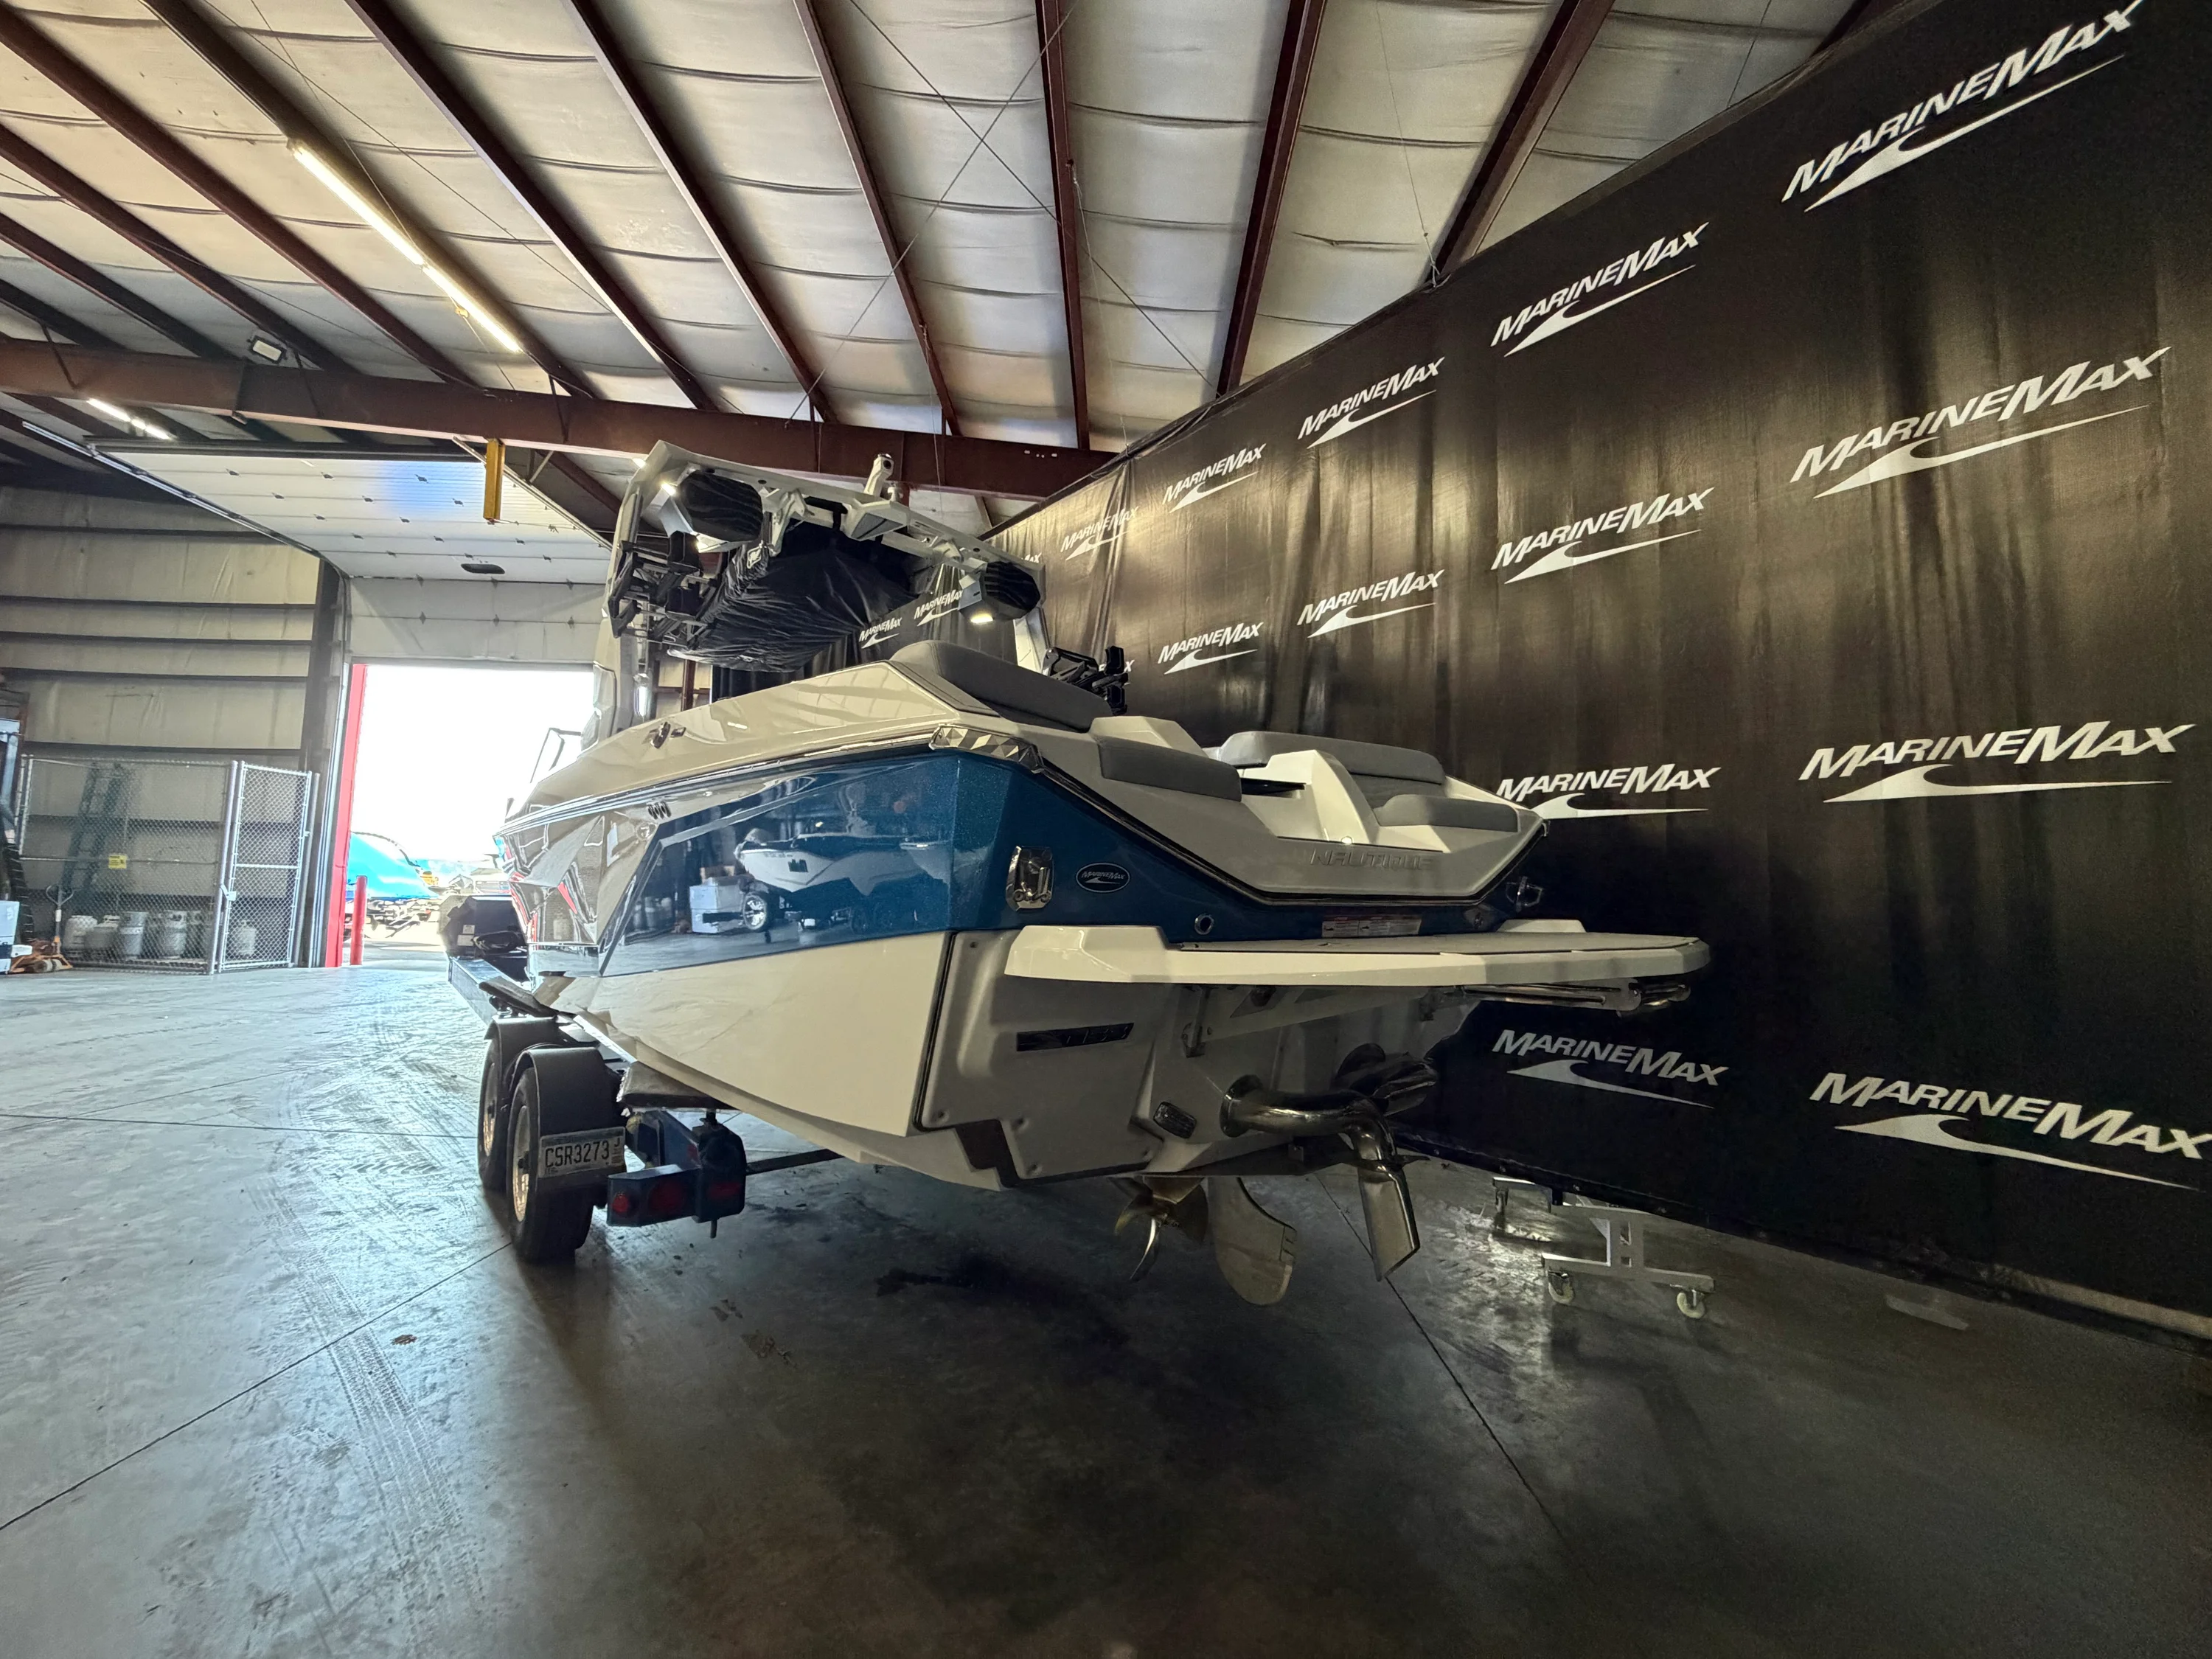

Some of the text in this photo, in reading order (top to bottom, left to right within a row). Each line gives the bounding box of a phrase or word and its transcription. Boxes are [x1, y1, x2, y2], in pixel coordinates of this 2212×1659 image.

[1781, 0, 2140, 202] MARINEMAX
[1491, 222, 1710, 347] MARINEMAX
[1298, 357, 1444, 439] MARINEMAX
[1790, 347, 2172, 483] MARINEMAX
[1163, 444, 1266, 504] MARINEMAX
[1060, 506, 1139, 552] MARINEMAX
[1491, 487, 1715, 570] MARINEMAX
[1297, 570, 1444, 625] MARINEMAX
[859, 617, 902, 642] MARINEMAX
[1158, 622, 1263, 664] MARINEMAX
[1798, 721, 2197, 780] MARINEMAX
[1496, 764, 1721, 802] MARINEMAX
[1310, 848, 1435, 871] NAUTIQUE
[1492, 1029, 1729, 1086] MARINEMAX
[1809, 1072, 2212, 1160] MARINEMAX
[546, 1141, 610, 1167] CSR3273
